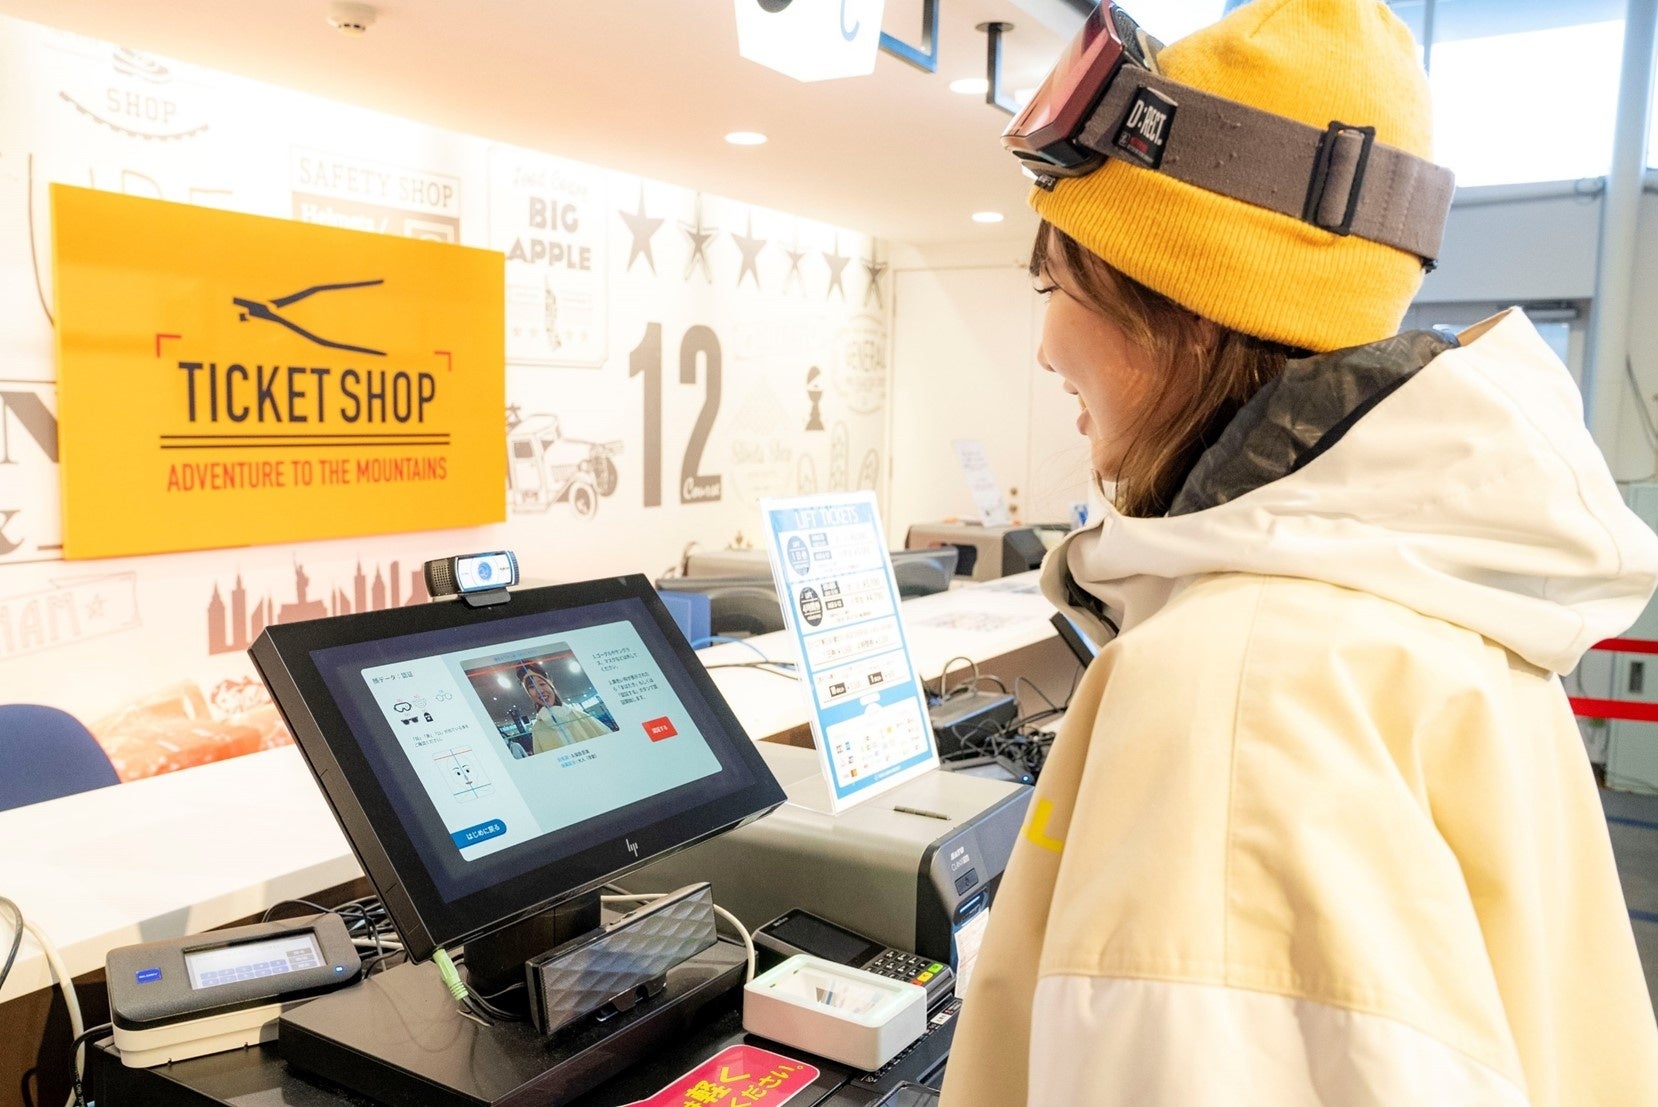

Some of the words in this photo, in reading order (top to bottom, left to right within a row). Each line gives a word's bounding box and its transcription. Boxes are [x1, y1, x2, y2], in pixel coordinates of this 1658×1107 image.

[106, 87, 177, 124] SHOP
[299, 157, 391, 197] SAFETY
[400, 177, 454, 208] SHOP
[529, 196, 579, 234] BIG
[506, 236, 592, 271] APPLE
[178, 361, 330, 423] TICKET
[340, 369, 436, 423] SHOP
[629, 321, 723, 507] 12
[167, 459, 285, 492] ADVENTURE
[291, 460, 313, 485] TO
[319, 459, 350, 484] THE
[356, 456, 448, 483] MOUNTAINS
[465, 824, 500, 840] はじめに戻る
